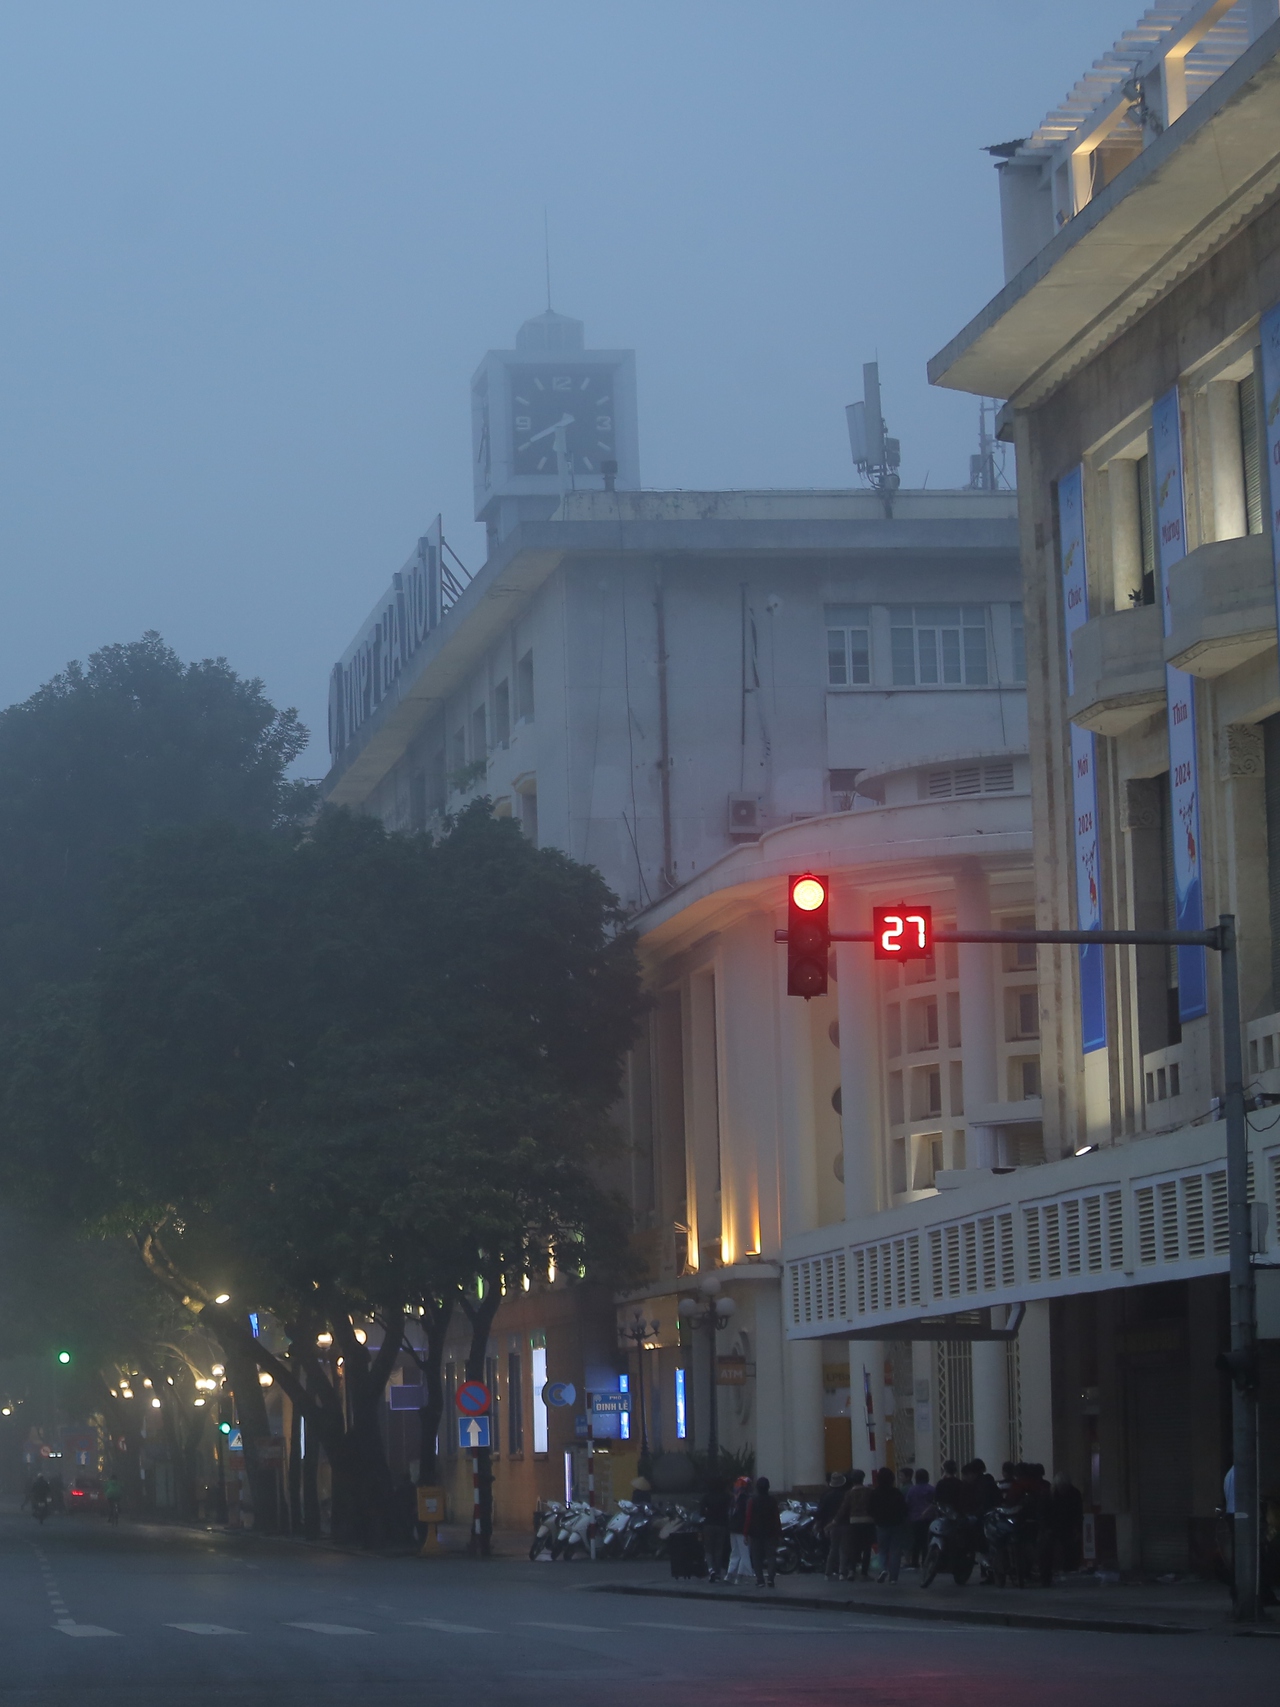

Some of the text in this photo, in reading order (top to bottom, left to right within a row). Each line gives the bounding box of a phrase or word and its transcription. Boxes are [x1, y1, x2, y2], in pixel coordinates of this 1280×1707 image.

[552, 376, 572, 391] 12
[516, 416, 531, 431] 9
[596, 416, 612, 431] 3
[1162, 517, 1181, 546] Mừng
[1067, 585, 1082, 610] Chúc
[1172, 700, 1188, 726] Thìn
[1077, 753, 1089, 778] Mới
[1174, 761, 1191, 788] 2024
[1078, 811, 1093, 836] 2024
[881, 915, 926, 951] 27
[720, 1368, 743, 1379] ATM
